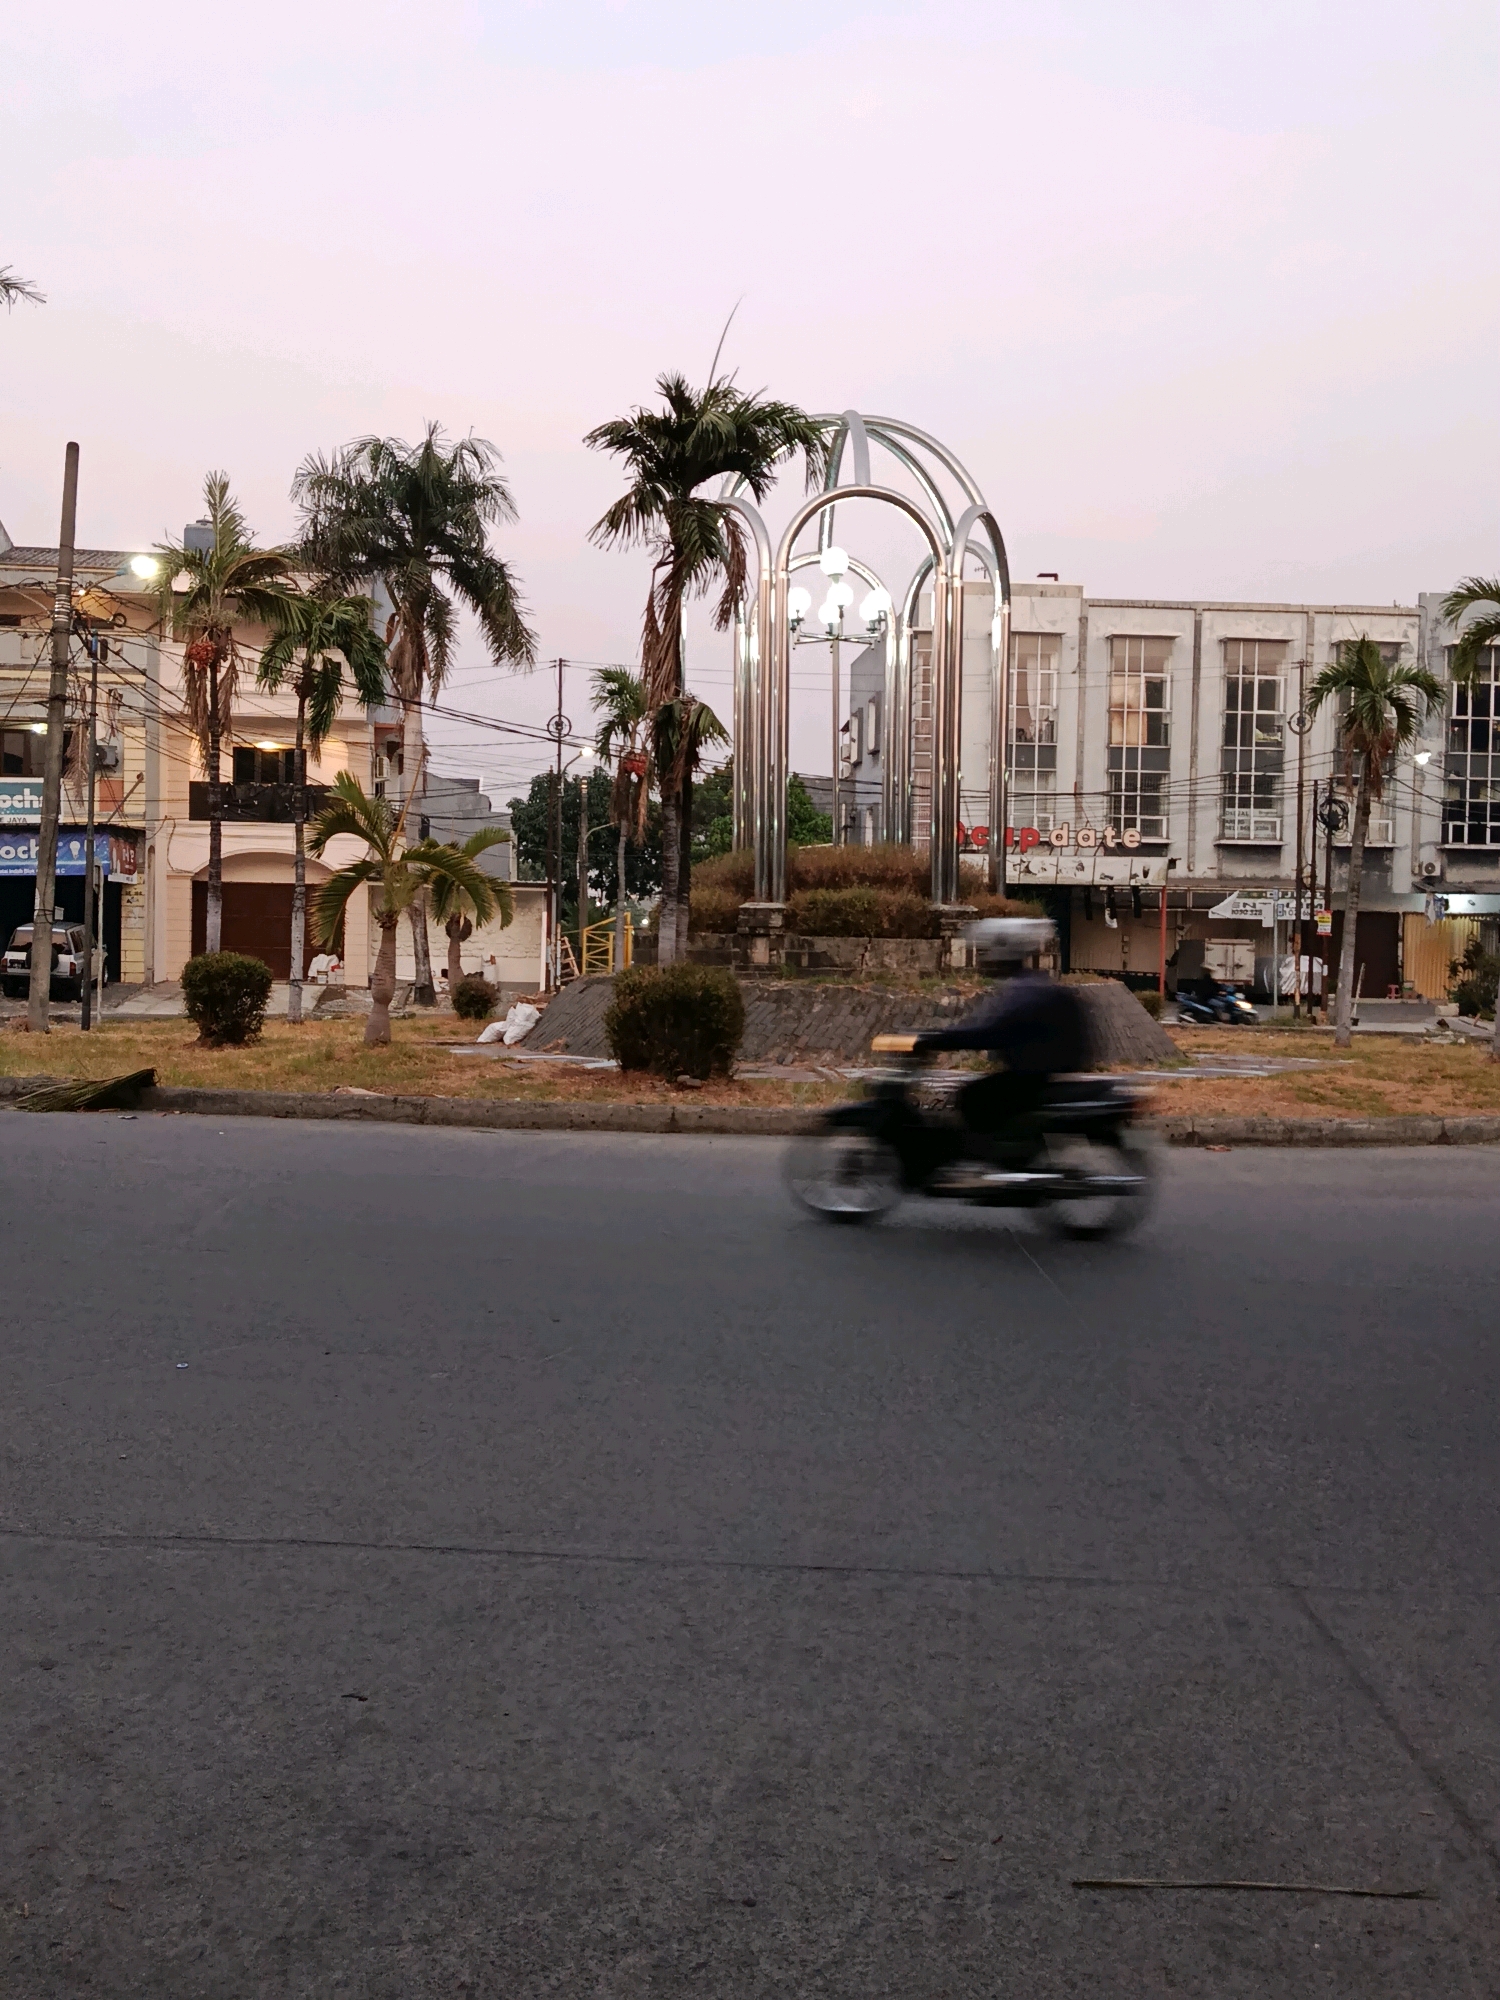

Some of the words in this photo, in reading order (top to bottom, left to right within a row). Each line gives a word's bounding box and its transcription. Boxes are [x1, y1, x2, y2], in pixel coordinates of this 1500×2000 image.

[0, 788, 43, 808] och
[1049, 822, 1142, 849] date
[0, 838, 58, 860] och
